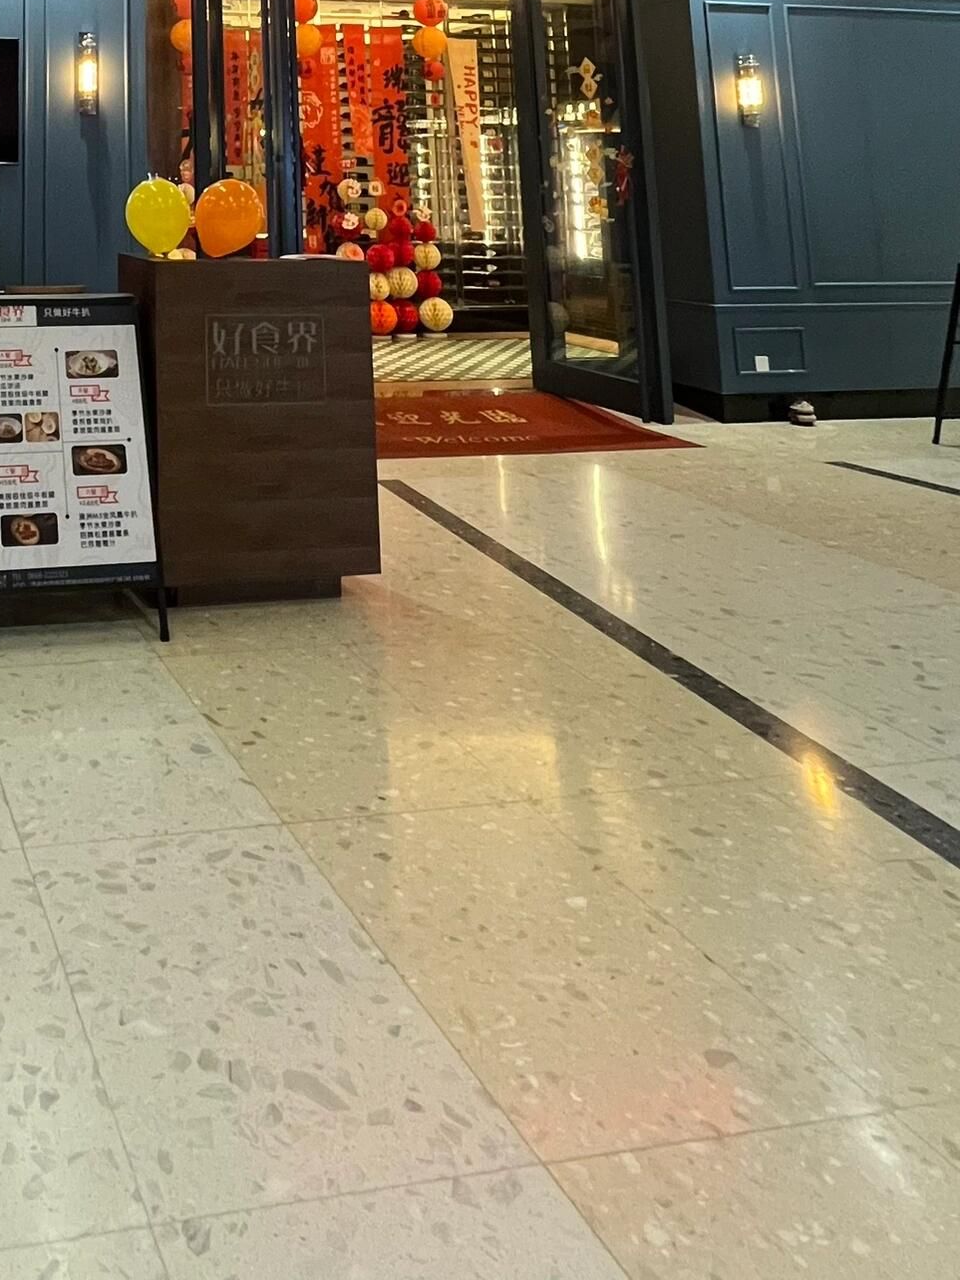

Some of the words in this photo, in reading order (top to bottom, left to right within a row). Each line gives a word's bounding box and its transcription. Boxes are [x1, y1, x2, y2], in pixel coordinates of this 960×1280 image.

[464, 66, 478, 128] HAPPY
[43, 307, 90, 317] 只做好牛扒
[212, 321, 318, 356] 好食界
[414, 435, 537, 444] Welcome
